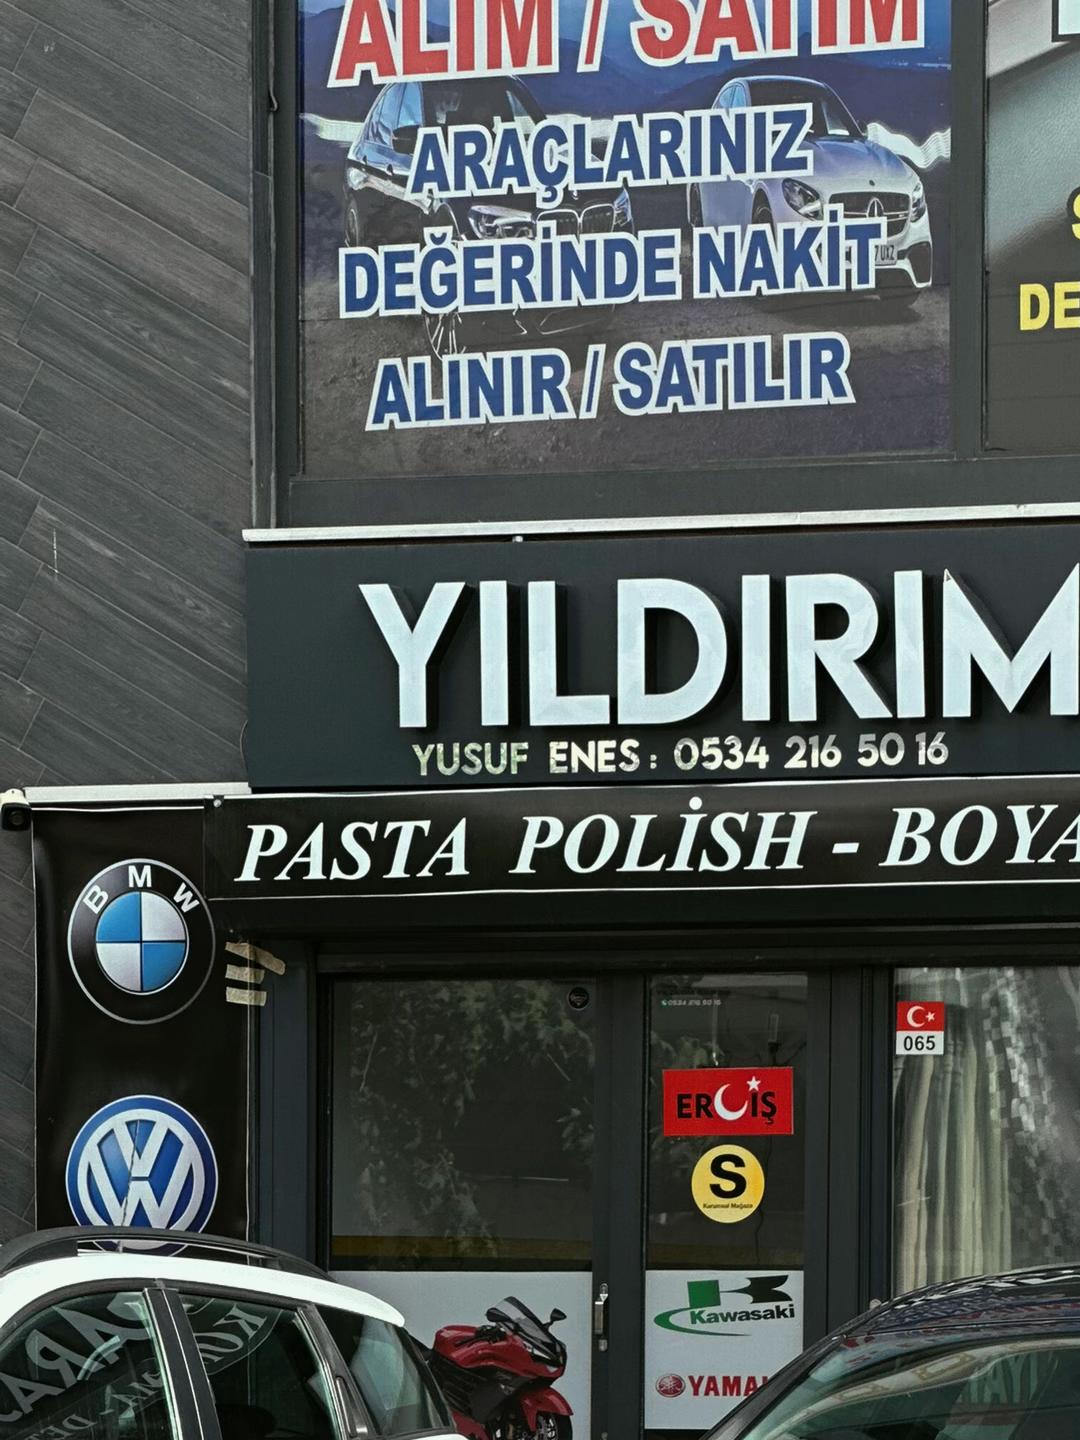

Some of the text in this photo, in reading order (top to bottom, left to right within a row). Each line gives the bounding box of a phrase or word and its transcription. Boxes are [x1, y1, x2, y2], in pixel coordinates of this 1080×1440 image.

[329, 0, 558, 87] ALIM
[406, 104, 813, 207] ARAÇLARINIZ
[339, 204, 887, 318] DEĞERİNDE NAKİT
[365, 347, 576, 430] ALINIR
[612, 332, 855, 414] SATILIR
[359, 563, 1080, 730] YILDIRIM
[412, 742, 529, 776] YUSUF
[673, 736, 769, 770] 0534
[784, 735, 842, 768] 216
[857, 733, 905, 766] 50
[914, 732, 949, 765] 16
[234, 818, 470, 883] PASTA
[508, 796, 818, 874] POLİSH
[83, 864, 200, 915] BMW
[903, 1035, 936, 1052] 065
[708, 1153, 748, 1200] S
[689, 1304, 796, 1325] Kawasaki
[688, 1375, 769, 1397] YAMA
